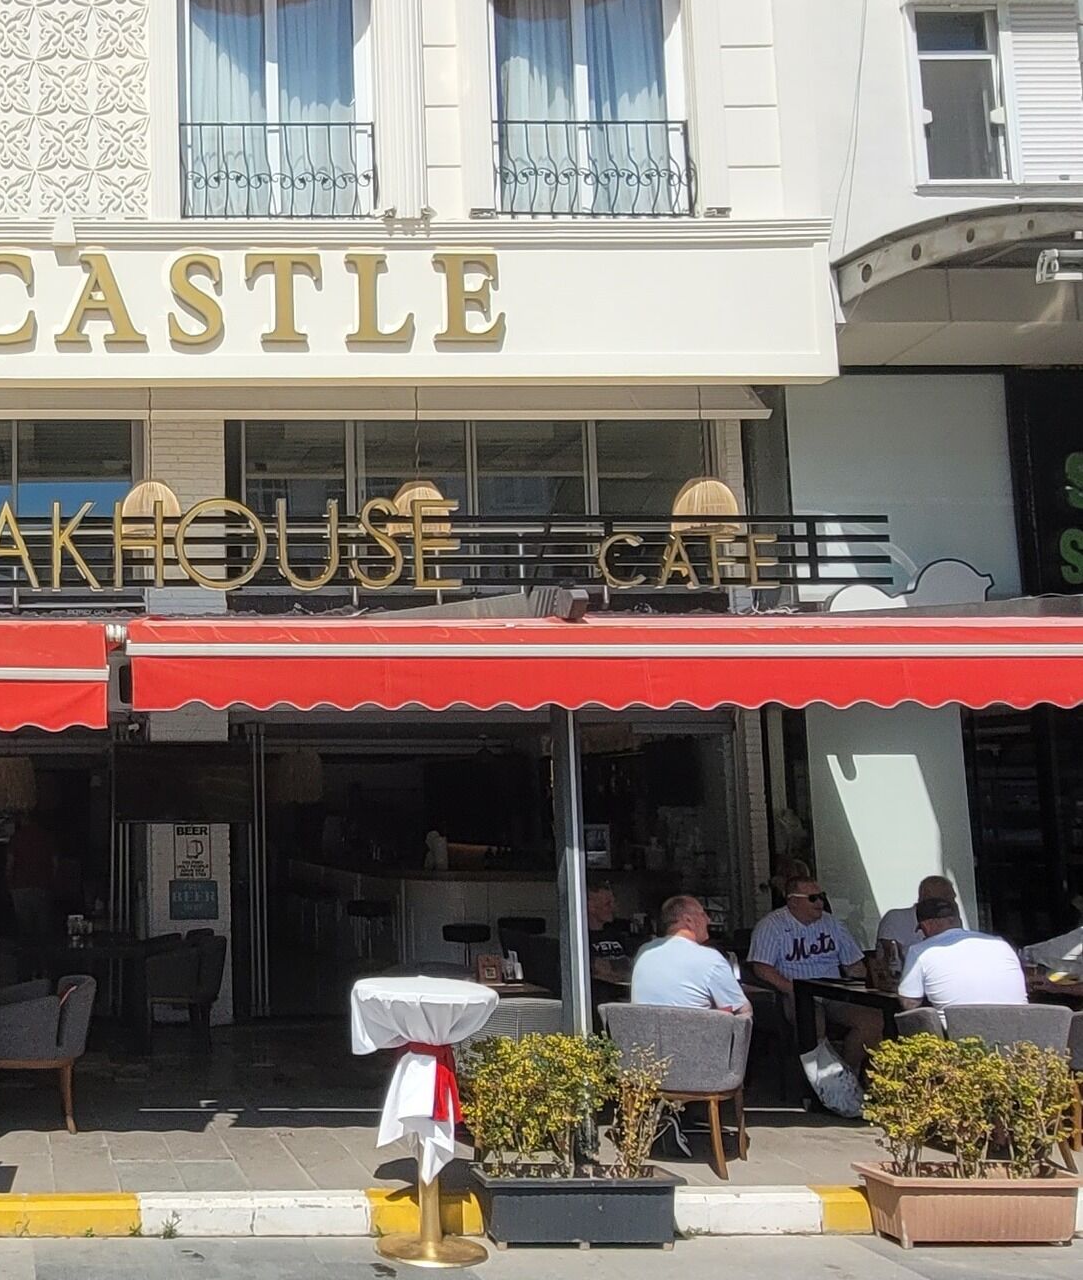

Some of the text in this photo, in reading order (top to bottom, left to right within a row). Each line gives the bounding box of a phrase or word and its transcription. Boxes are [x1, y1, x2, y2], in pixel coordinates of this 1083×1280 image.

[598, 531, 781, 590] CAFE
[176, 826, 209, 837] BEER
[785, 932, 836, 961] Mets
